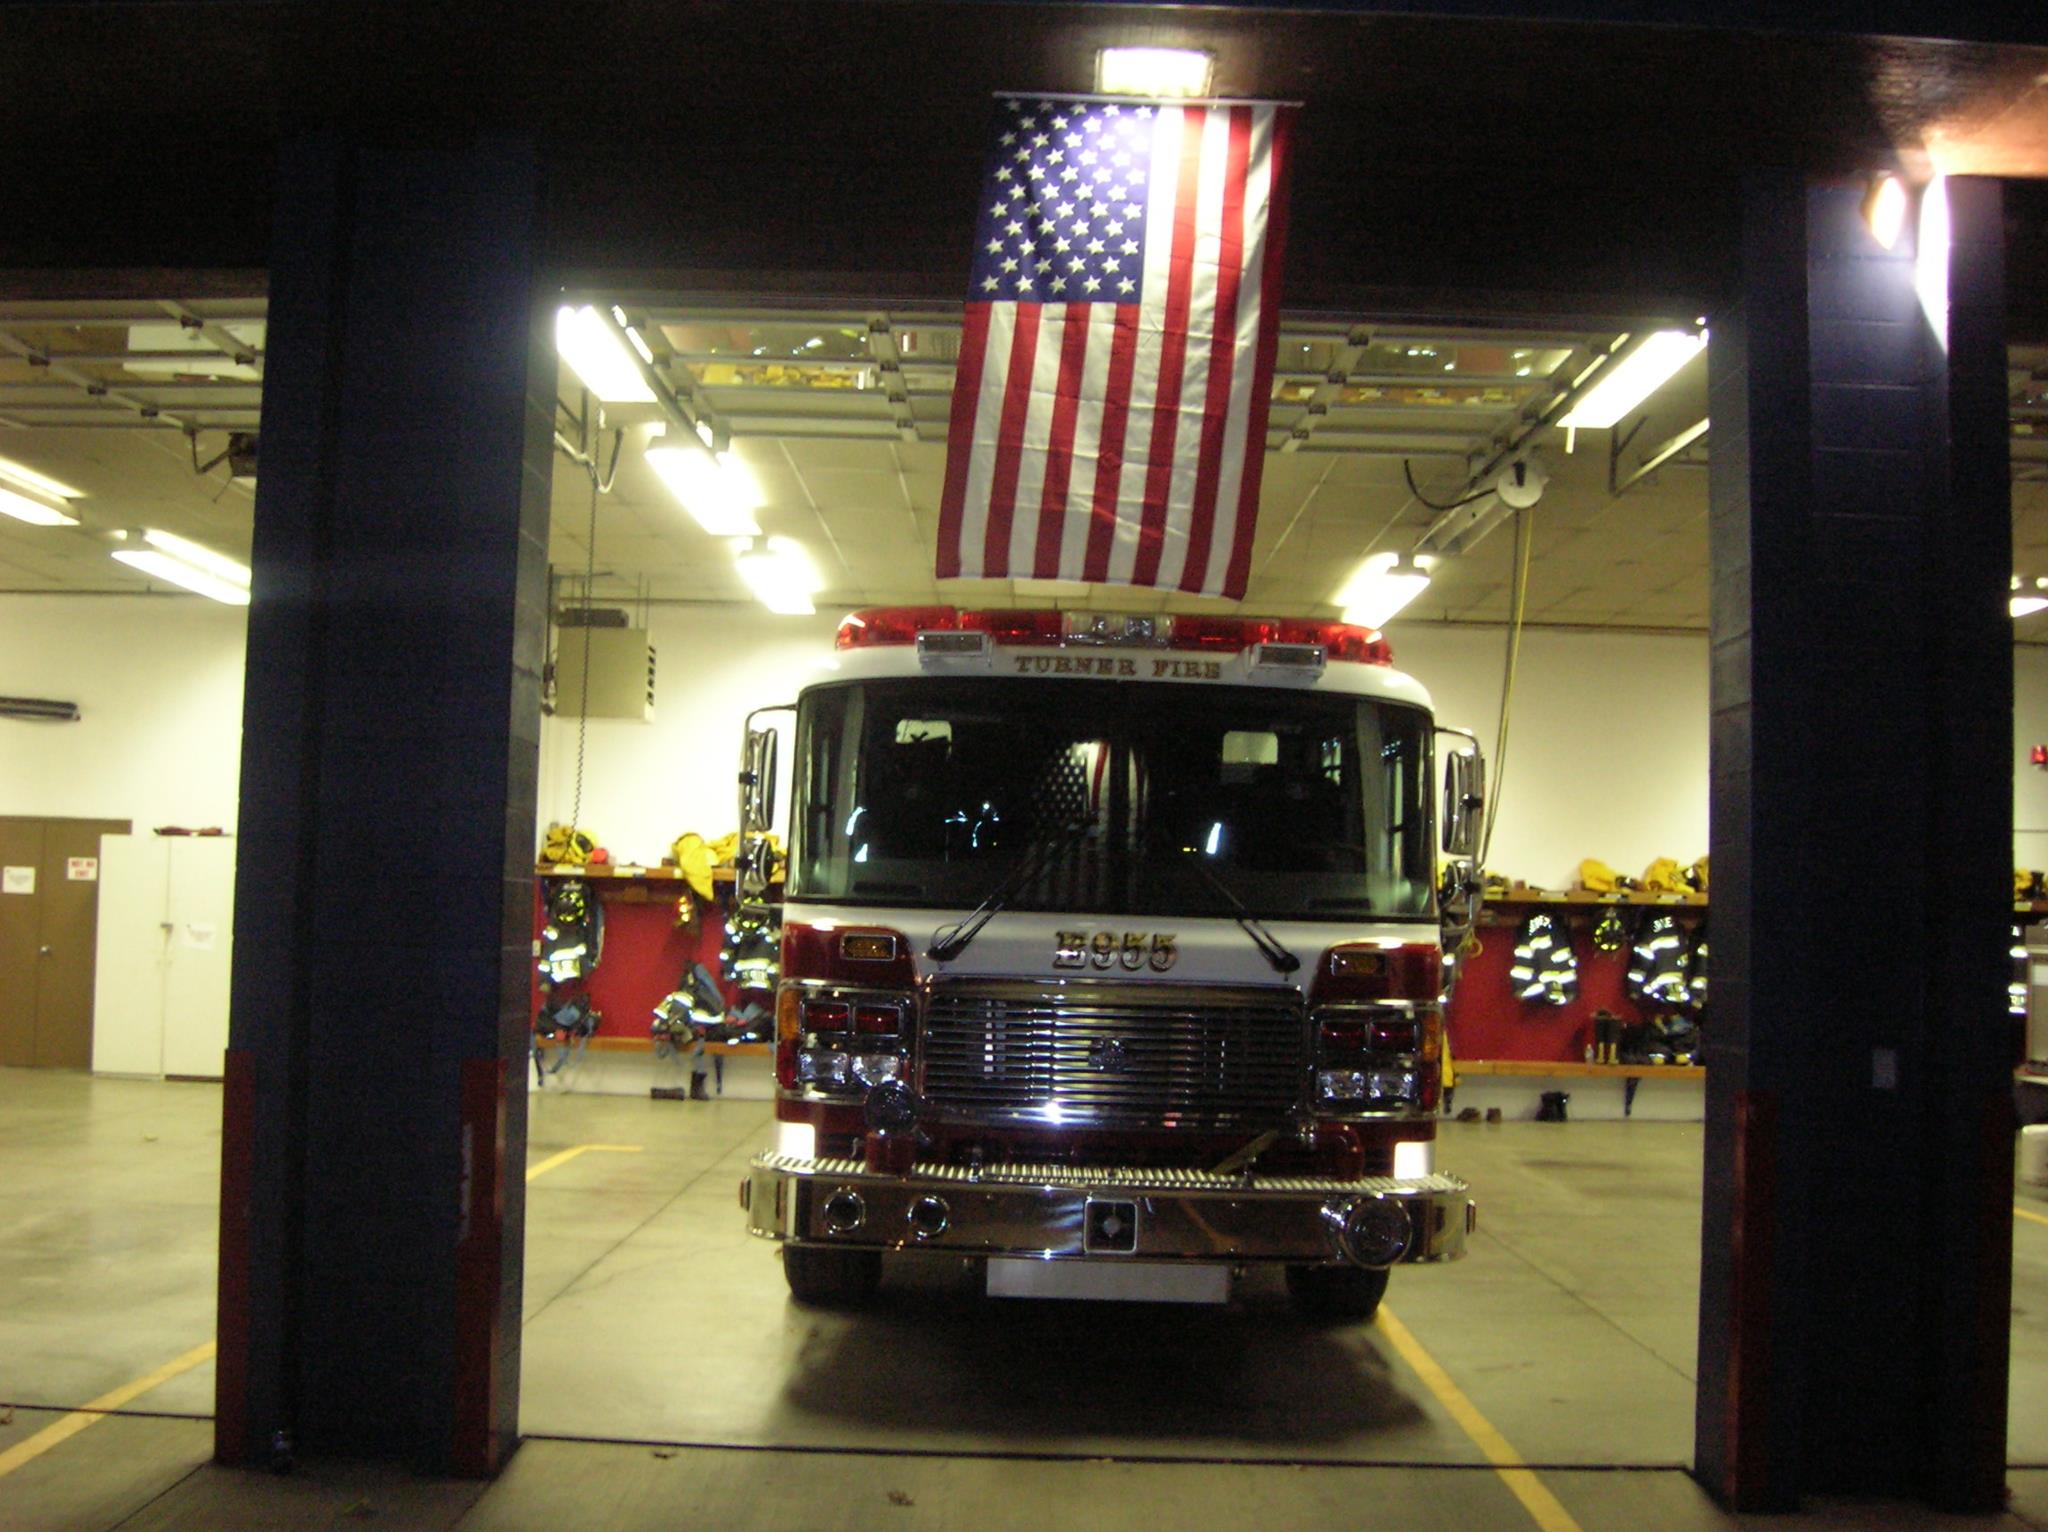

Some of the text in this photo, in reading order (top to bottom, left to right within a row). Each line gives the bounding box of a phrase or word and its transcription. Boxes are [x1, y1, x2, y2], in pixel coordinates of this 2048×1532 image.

[1015, 655, 1222, 680] TURNER FIRE
[1053, 931, 1178, 972] E955
